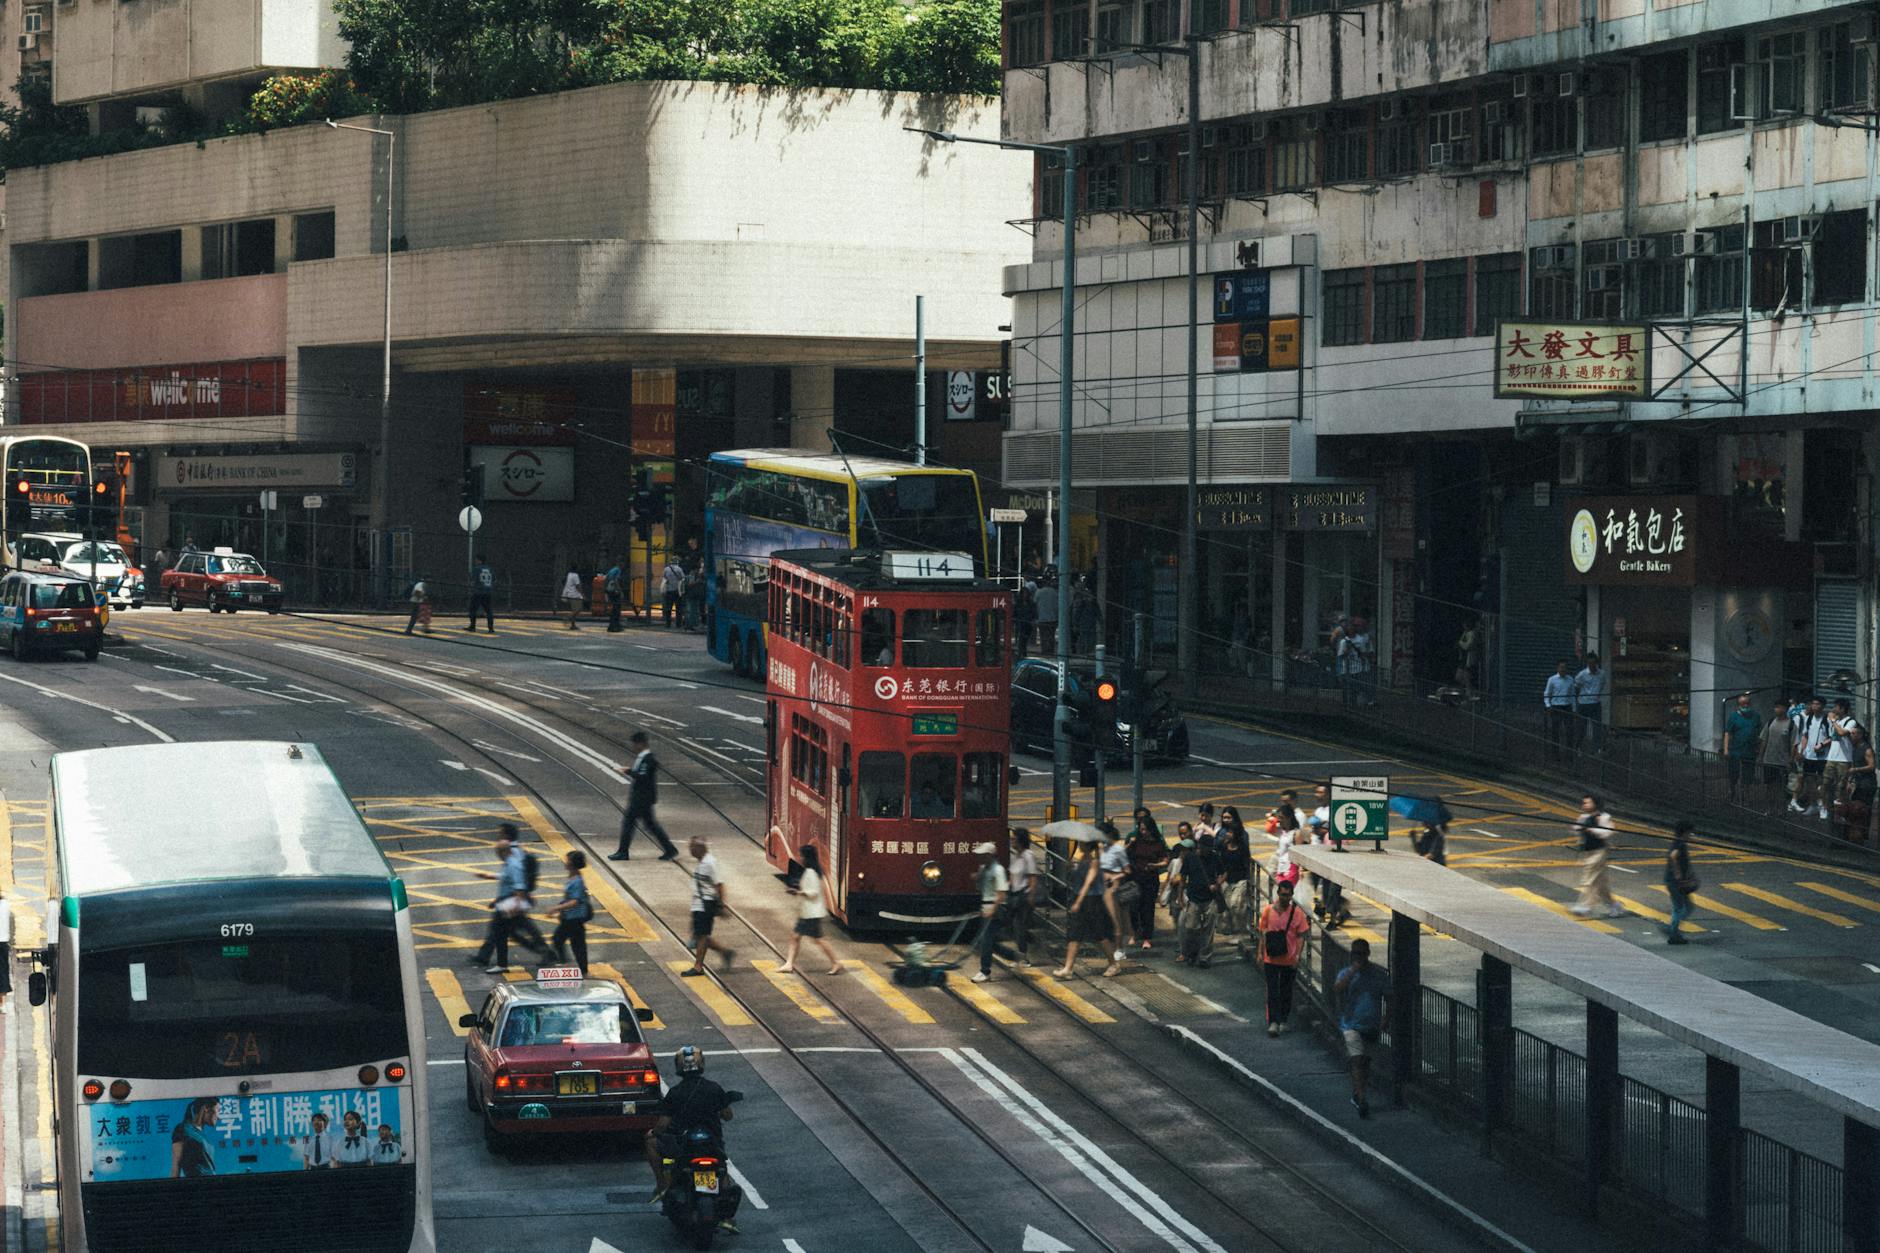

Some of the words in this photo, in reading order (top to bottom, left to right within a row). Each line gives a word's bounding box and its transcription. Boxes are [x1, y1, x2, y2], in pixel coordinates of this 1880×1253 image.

[1507, 329, 1638, 361] 大發文具
[1507, 363, 1570, 380] 影印傳真
[150, 371, 220, 406] wellcome
[949, 384, 974, 396] スシロー
[501, 467, 545, 479] スシロー
[1602, 507, 1685, 555] 和氣包店
[918, 558, 952, 576] 114
[863, 596, 878, 608] 114
[992, 597, 1006, 608] 114
[220, 923, 255, 937] 6179
[541, 969, 579, 978] TAXI
[223, 1032, 261, 1067] 2A
[215, 1091, 382, 1139] 學制勝利組
